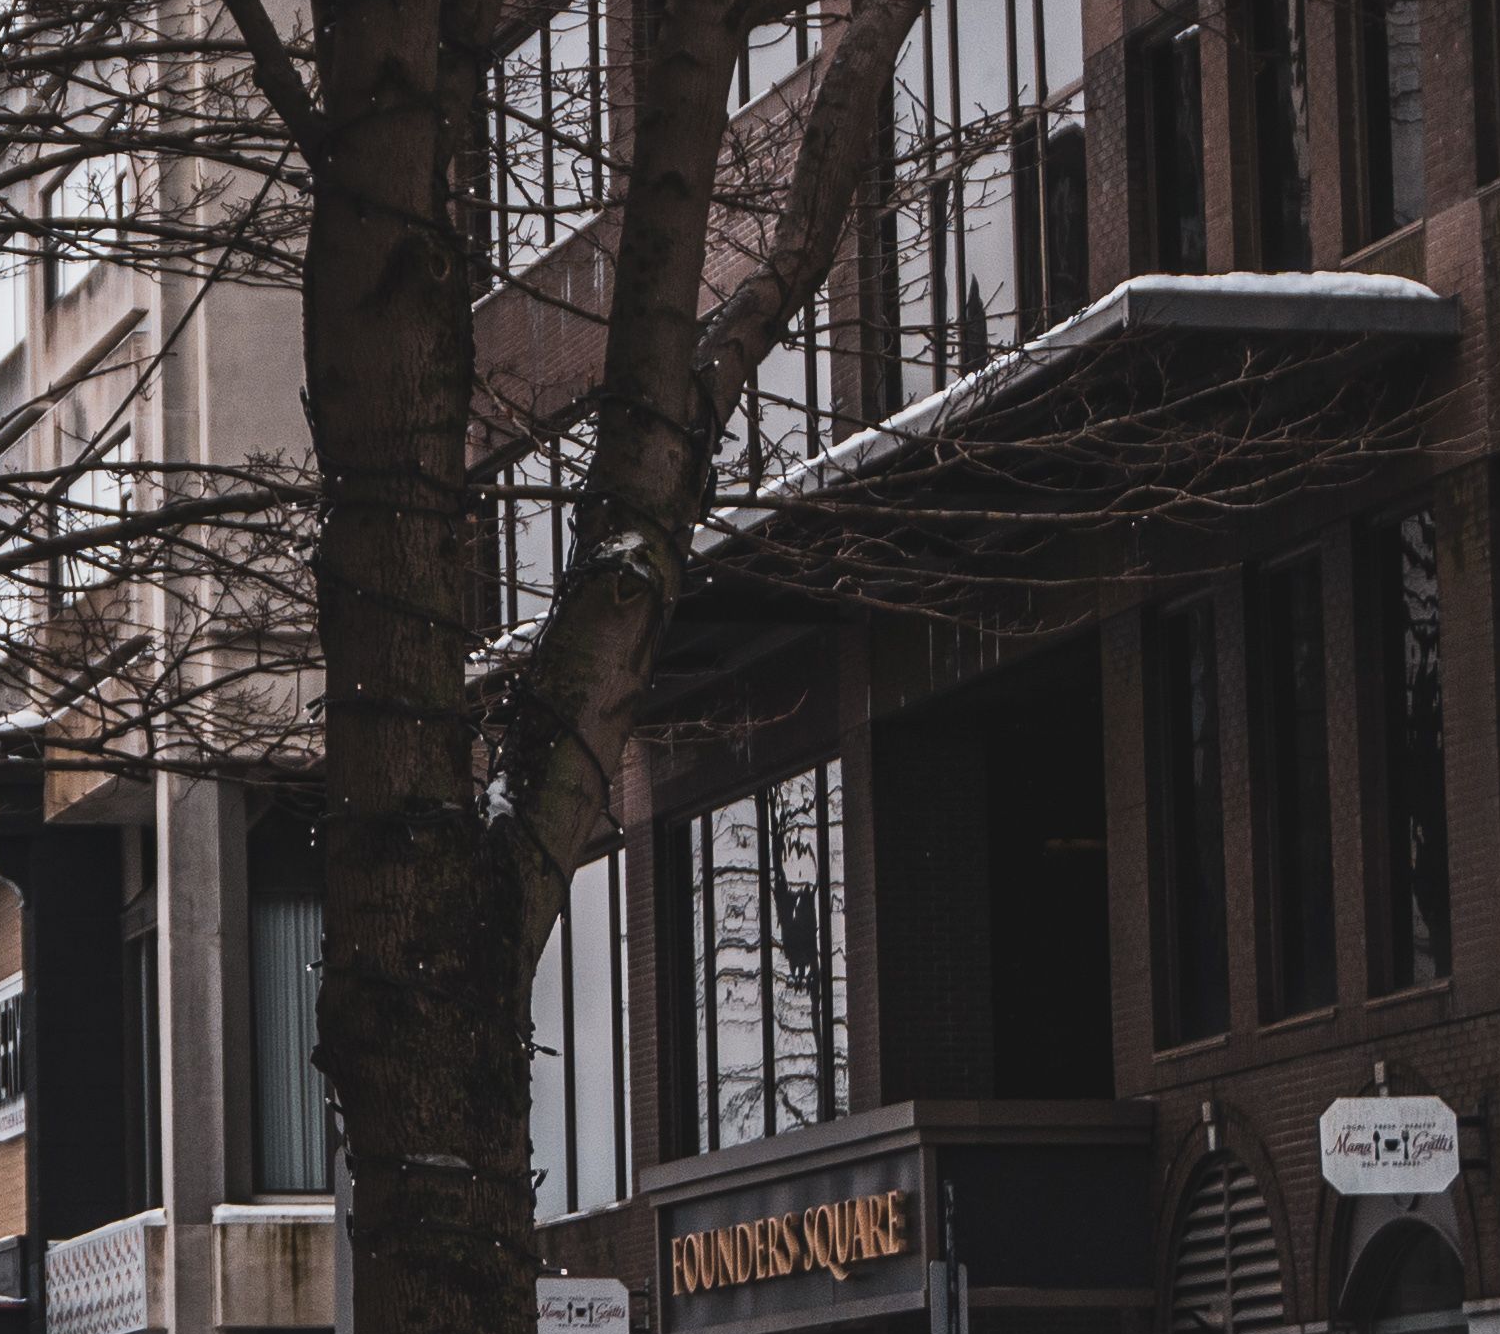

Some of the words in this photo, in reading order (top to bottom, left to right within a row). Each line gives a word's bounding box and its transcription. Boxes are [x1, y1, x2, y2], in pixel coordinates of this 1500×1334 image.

[1325, 1130, 1373, 1156] Mama
[672, 1212, 801, 1296] FOUNDERS
[803, 1190, 902, 1281] SQUARE
